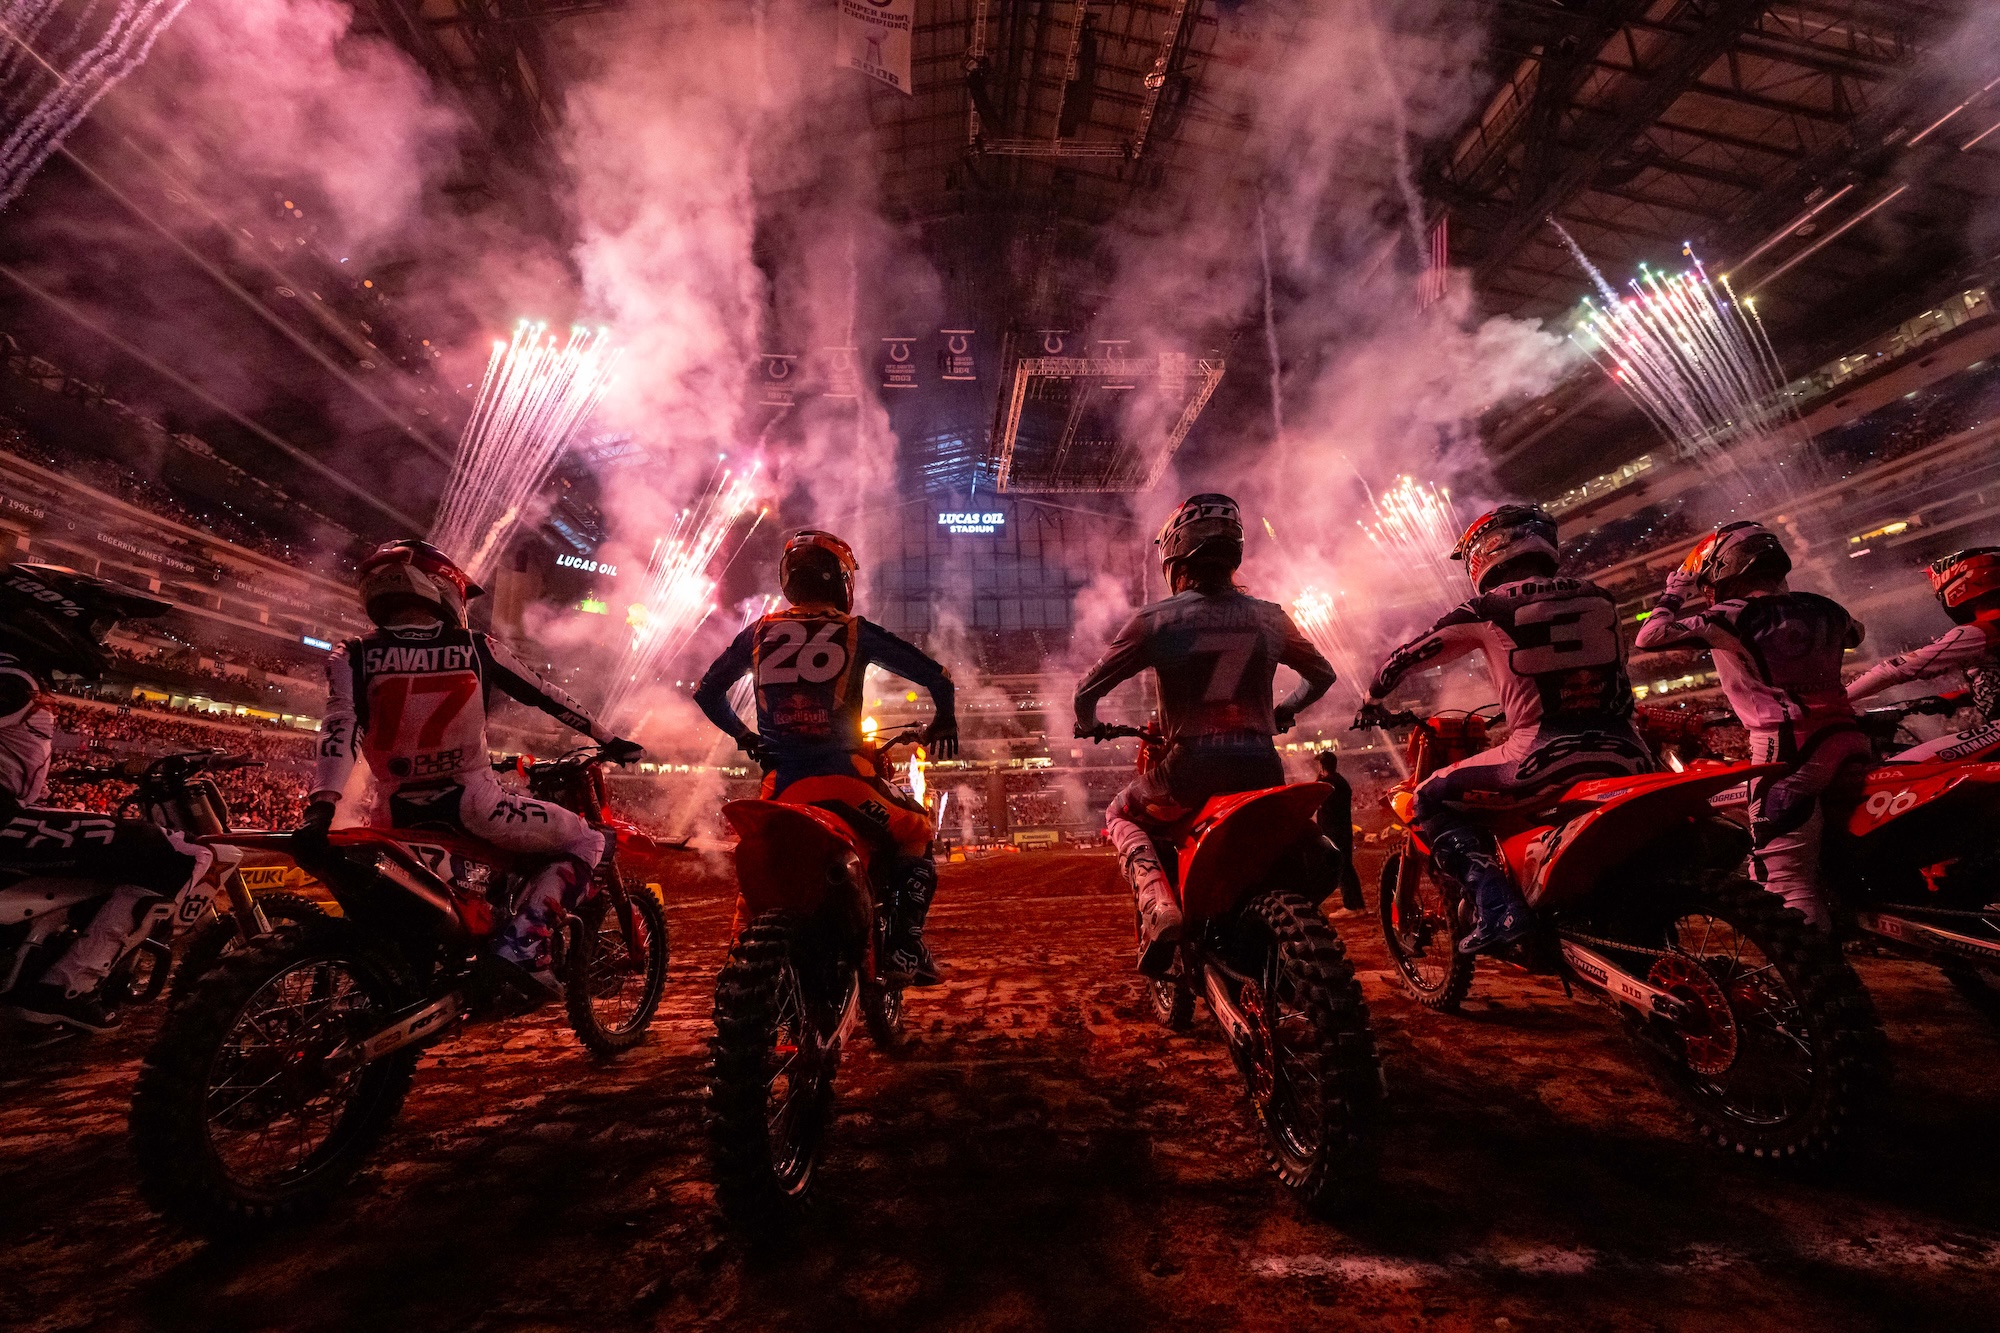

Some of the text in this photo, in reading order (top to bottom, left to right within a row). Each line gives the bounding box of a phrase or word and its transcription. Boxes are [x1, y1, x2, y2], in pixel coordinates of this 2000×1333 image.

[844, 7, 908, 31] CHAMPIONS
[9, 499, 45, 519] 1996-08
[938, 513, 1005, 524] LUCAS OIL
[950, 525, 994, 533] STADIUM
[97, 533, 137, 553] EDGERRIN
[137, 550, 163, 563] JAMES
[556, 554, 618, 576] LUCAS OIL
[4, 576, 85, 617] 100%
[237, 581, 252, 593] ERIC
[1512, 596, 1617, 673] 3
[366, 645, 473, 673] SAVATGY
[759, 621, 846, 686] 26
[1190, 632, 1260, 700] 7
[370, 673, 477, 752] 17
[414, 749, 463, 765] QUAD
[414, 760, 465, 776] LOCK
[857, 800, 891, 826] KTM
[1866, 785, 1918, 819] 96
[241, 870, 284, 884] ZUKI
[907, 877, 927, 895] FOX
[1621, 983, 1642, 1000] DID
